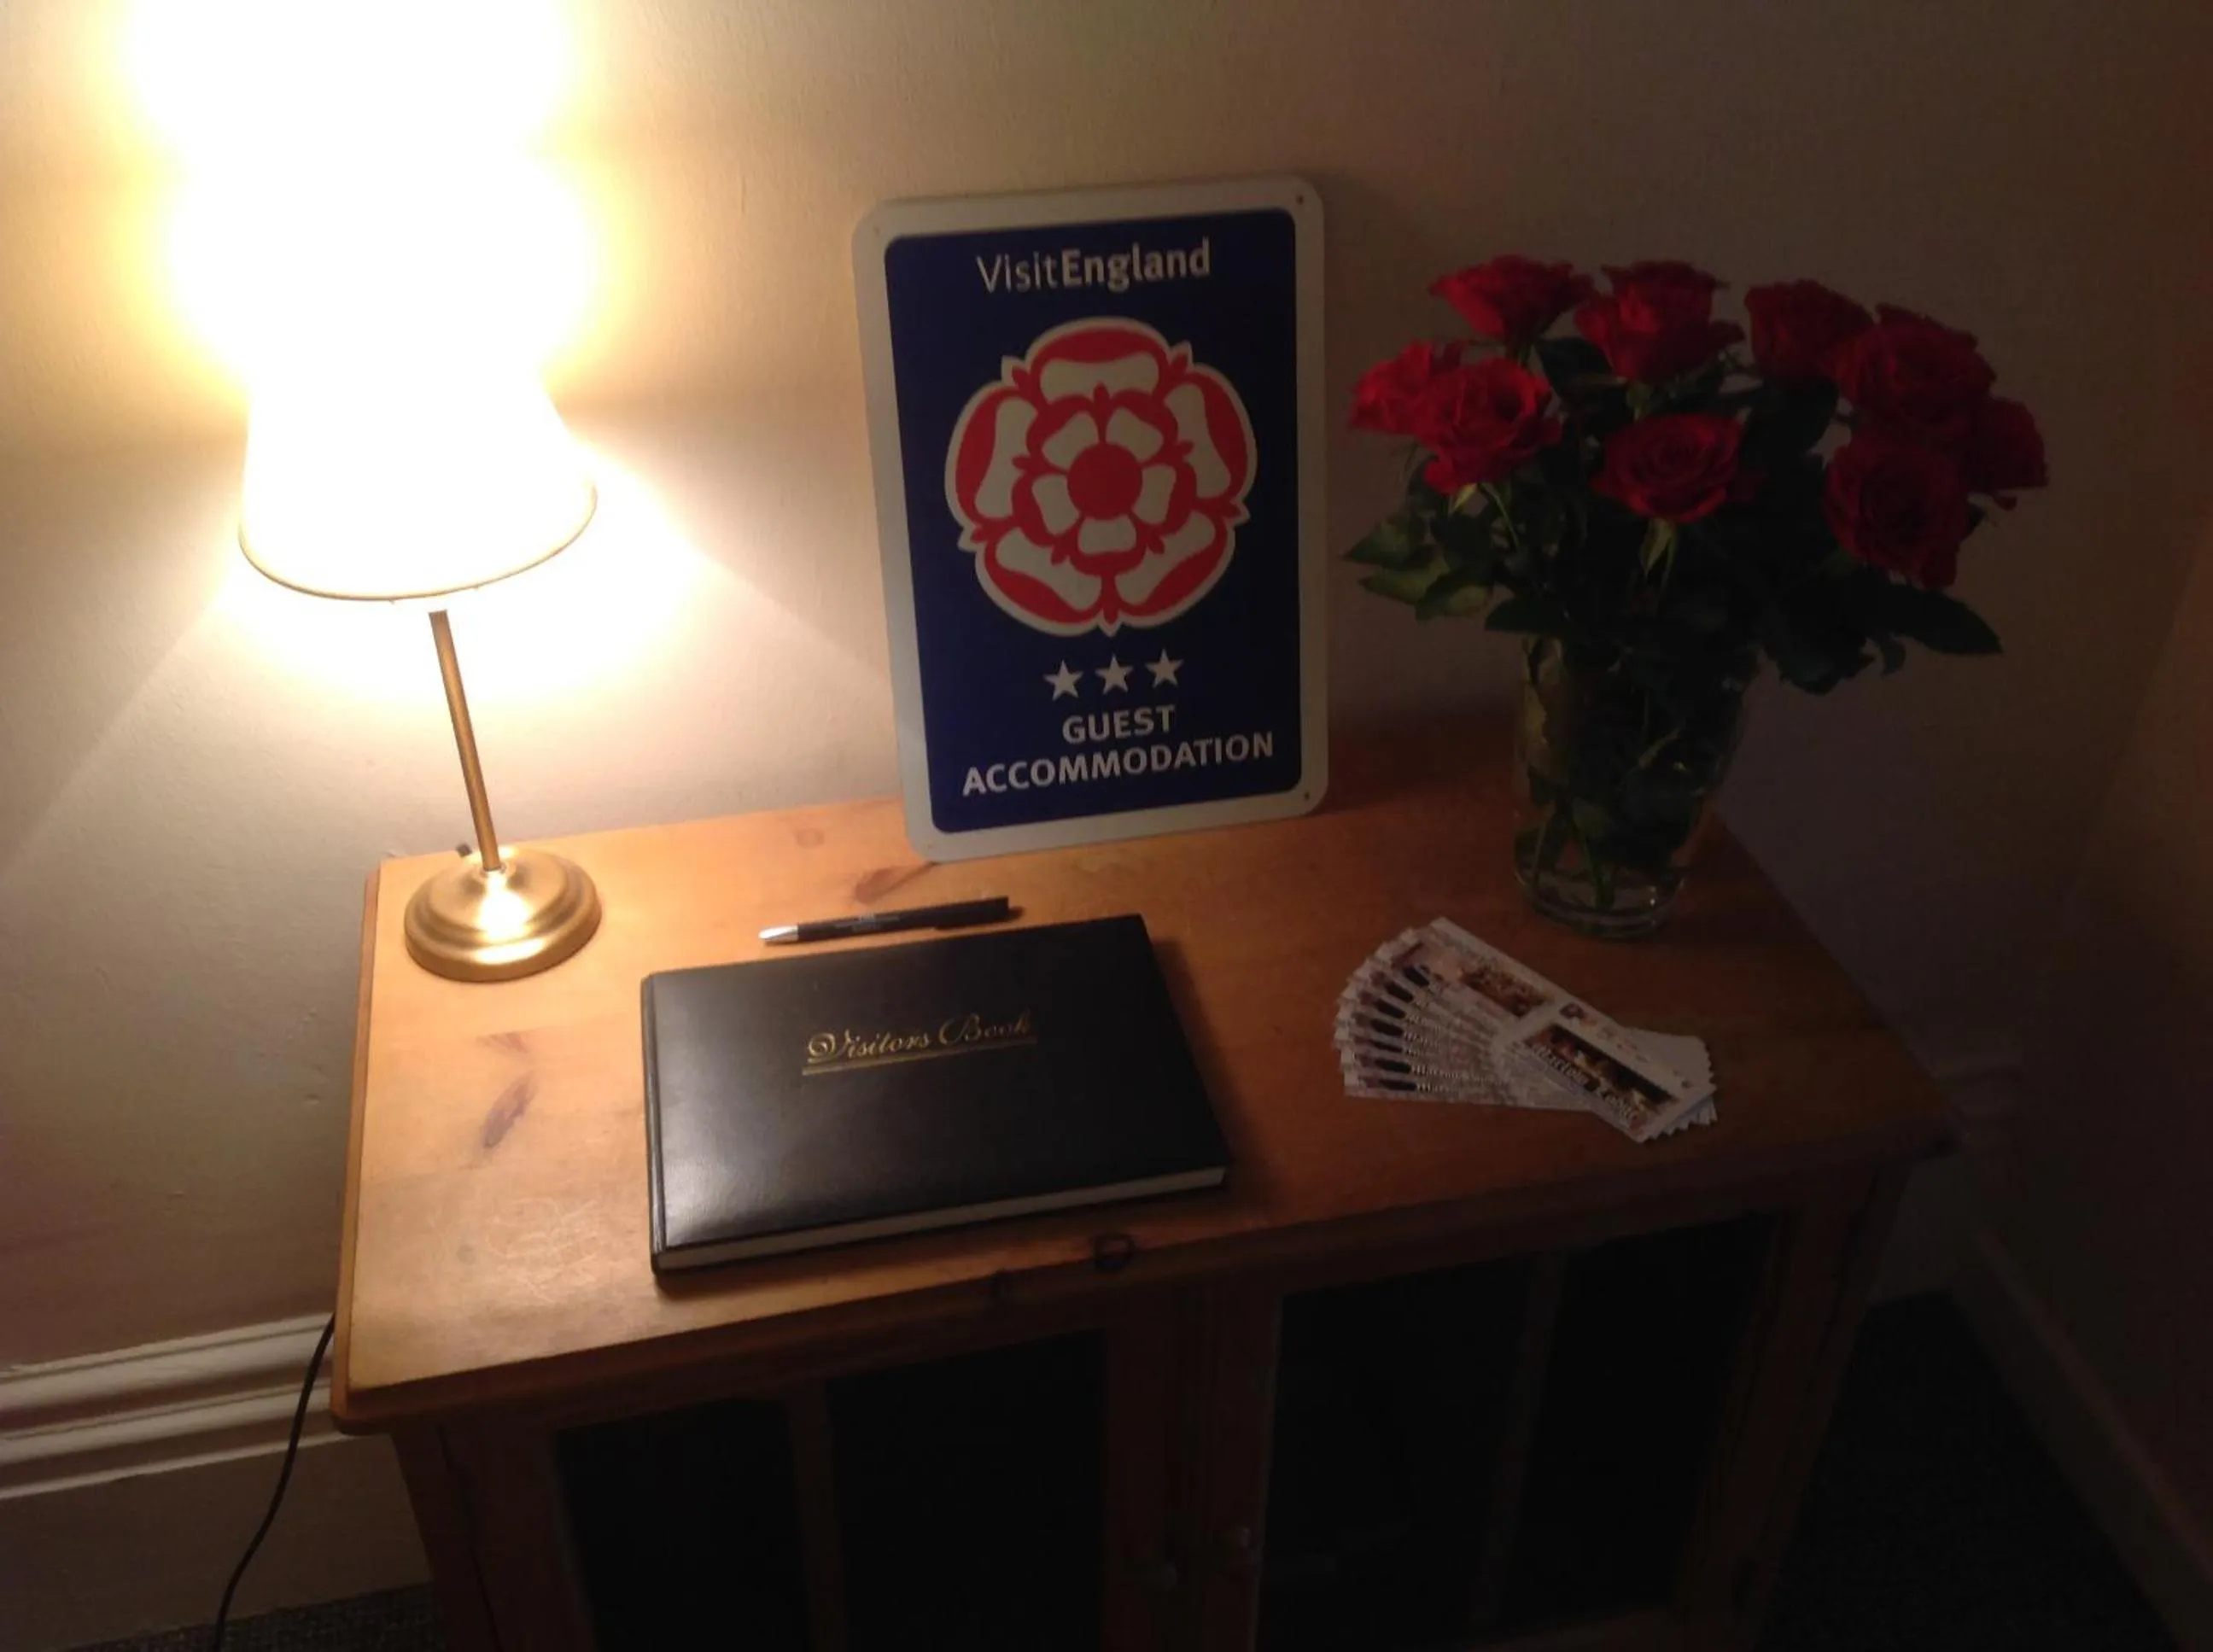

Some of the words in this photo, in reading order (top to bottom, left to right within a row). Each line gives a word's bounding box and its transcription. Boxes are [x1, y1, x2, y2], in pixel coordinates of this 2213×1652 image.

[976, 236, 1211, 293] VisitEngland
[1061, 704, 1176, 745] GUEST
[961, 731, 1274, 797] ACCOMMODATION
[806, 1028, 931, 1063] Visitors
[938, 1008, 1031, 1044] Book
